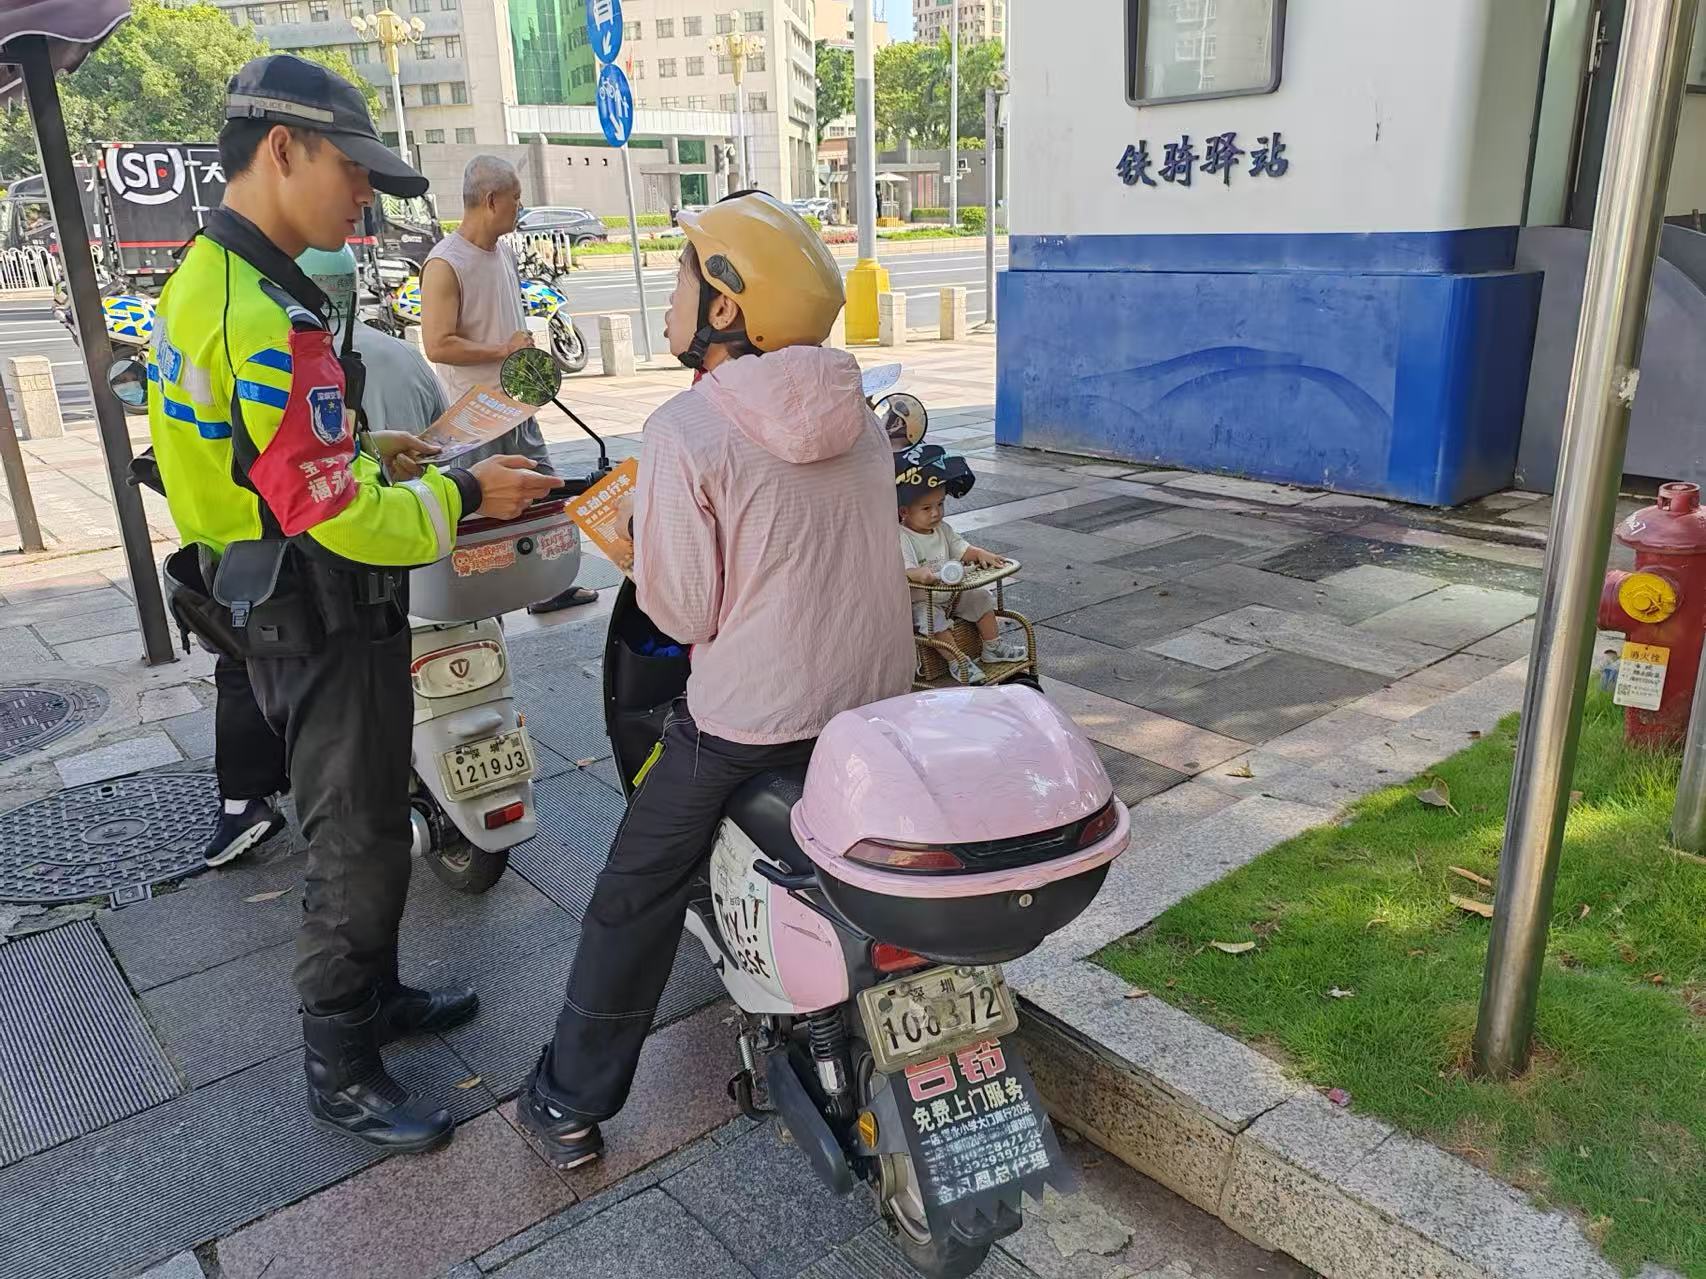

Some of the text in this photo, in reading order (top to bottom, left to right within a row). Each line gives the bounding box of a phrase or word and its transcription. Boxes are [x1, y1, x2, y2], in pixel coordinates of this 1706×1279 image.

[122, 152, 169, 189] SF
[1116, 132, 1288, 187] 铁骑驿站
[576, 474, 631, 516] 电动自行车
[455, 750, 525, 786] 1219J3
[909, 977, 956, 1002] 深圳
[913, 1076, 1024, 1135] 免费上门服务
